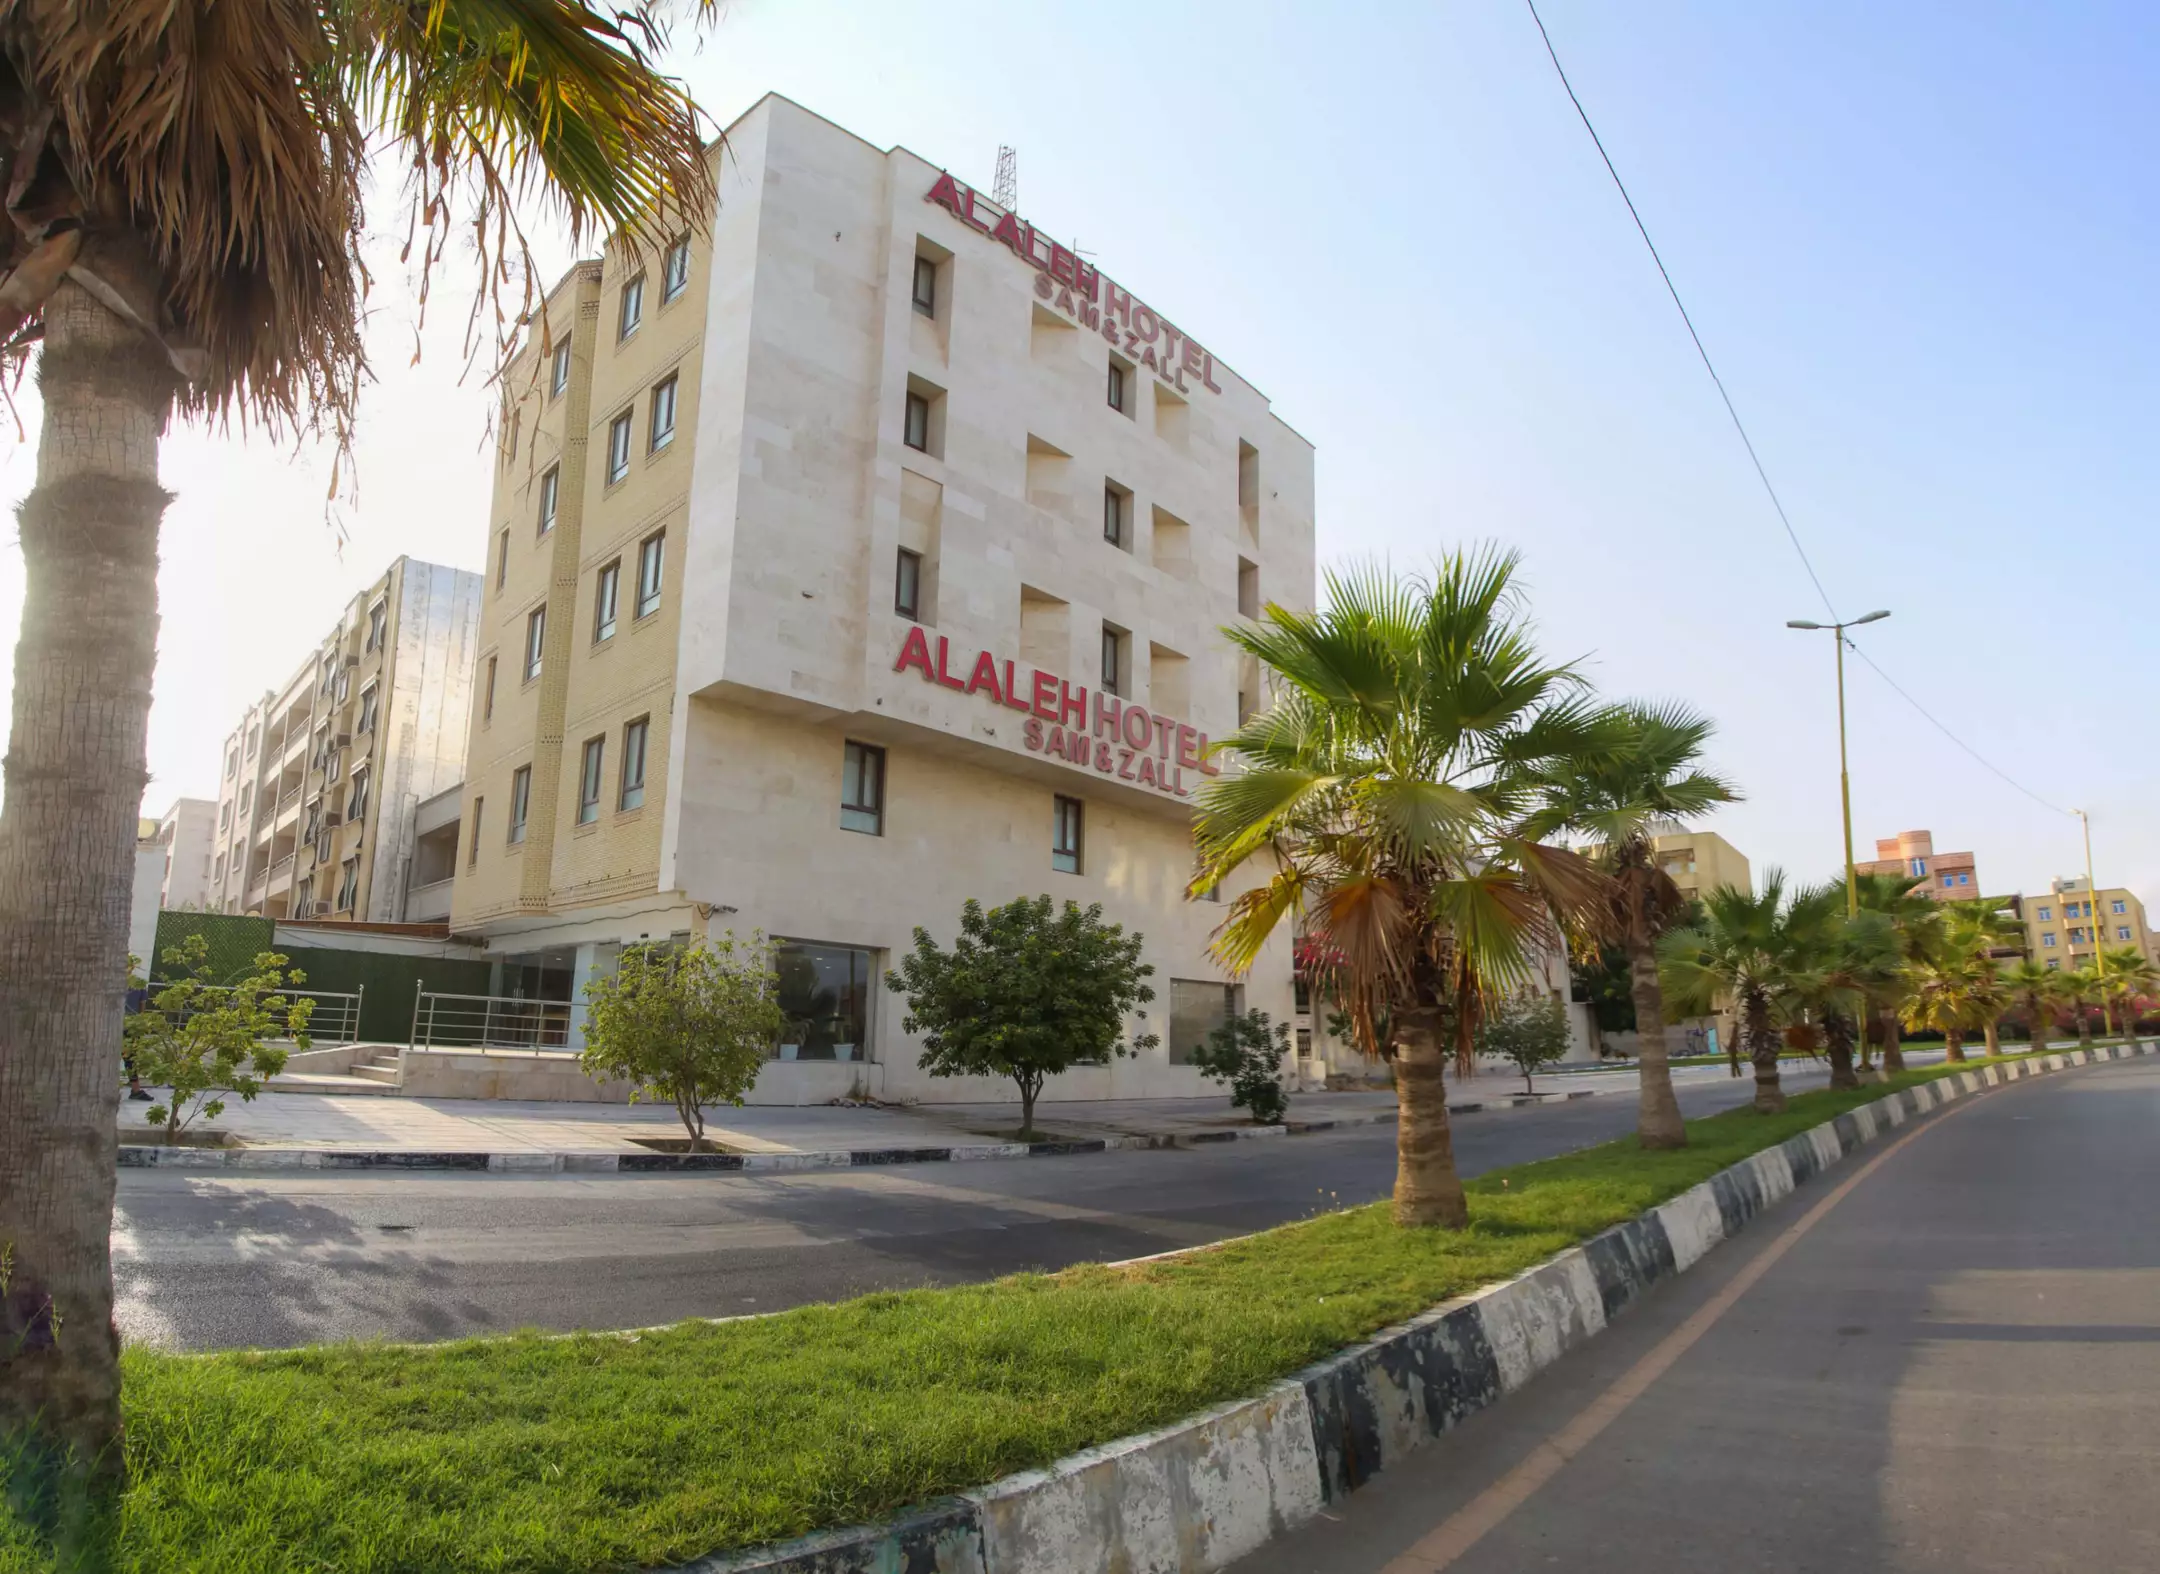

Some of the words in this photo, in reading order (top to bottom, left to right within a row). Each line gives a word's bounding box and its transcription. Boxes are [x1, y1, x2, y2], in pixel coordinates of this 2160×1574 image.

[926, 172, 1099, 303] ALALEH
[1105, 282, 1222, 395] HOTEL
[1033, 272, 1099, 333] SAM
[1101, 318, 1120, 346] &
[1123, 331, 1189, 394] ZALL
[893, 626, 1087, 731] ALALEH
[1094, 691, 1219, 777] HOTEL
[1024, 717, 1090, 767] SAM
[1094, 742, 1114, 774] &
[1118, 749, 1189, 797] ZALL
